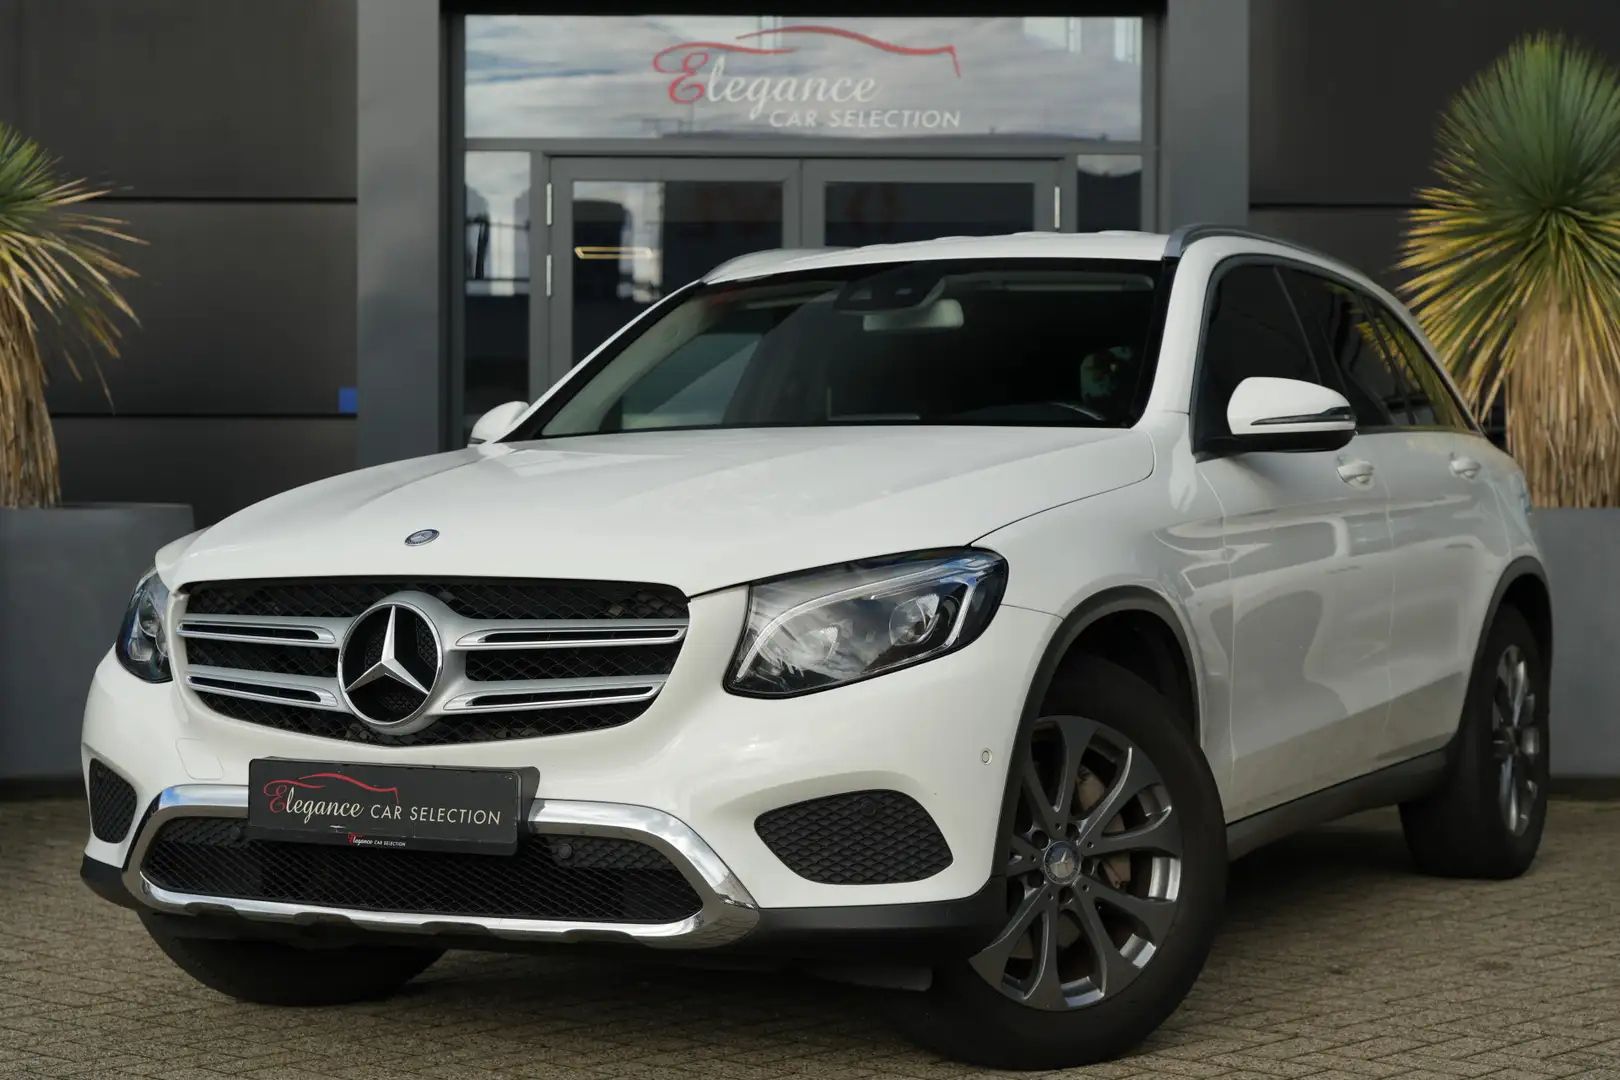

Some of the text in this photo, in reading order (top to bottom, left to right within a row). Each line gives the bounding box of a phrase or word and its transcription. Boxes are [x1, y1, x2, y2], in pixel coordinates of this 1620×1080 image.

[654, 50, 878, 119] Elegance
[769, 109, 961, 128] CAR SELECTION
[264, 784, 501, 825] Elegance CAR SELECTION
